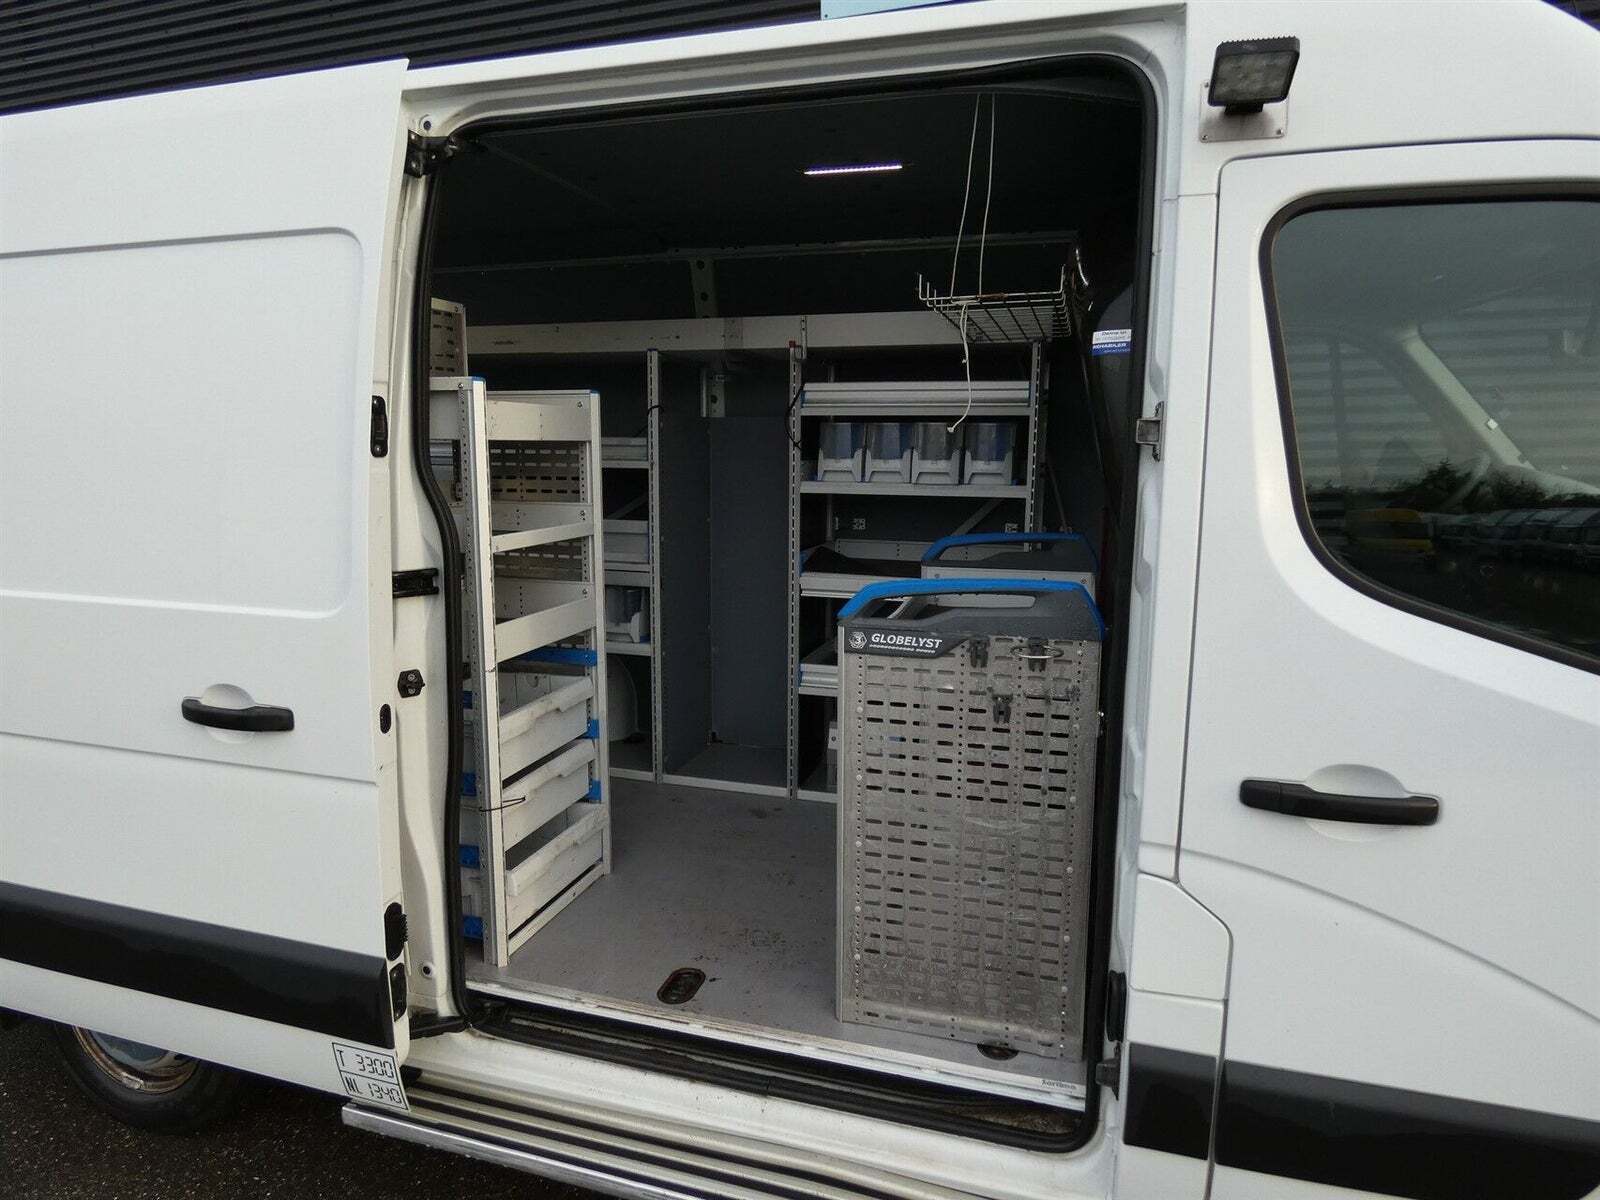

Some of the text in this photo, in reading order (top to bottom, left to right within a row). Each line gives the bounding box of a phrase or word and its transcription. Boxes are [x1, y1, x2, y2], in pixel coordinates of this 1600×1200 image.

[871, 633, 943, 649] GLOBELYST
[336, 1049, 395, 1079] T 3300
[367, 1083, 403, 1105] 1340
